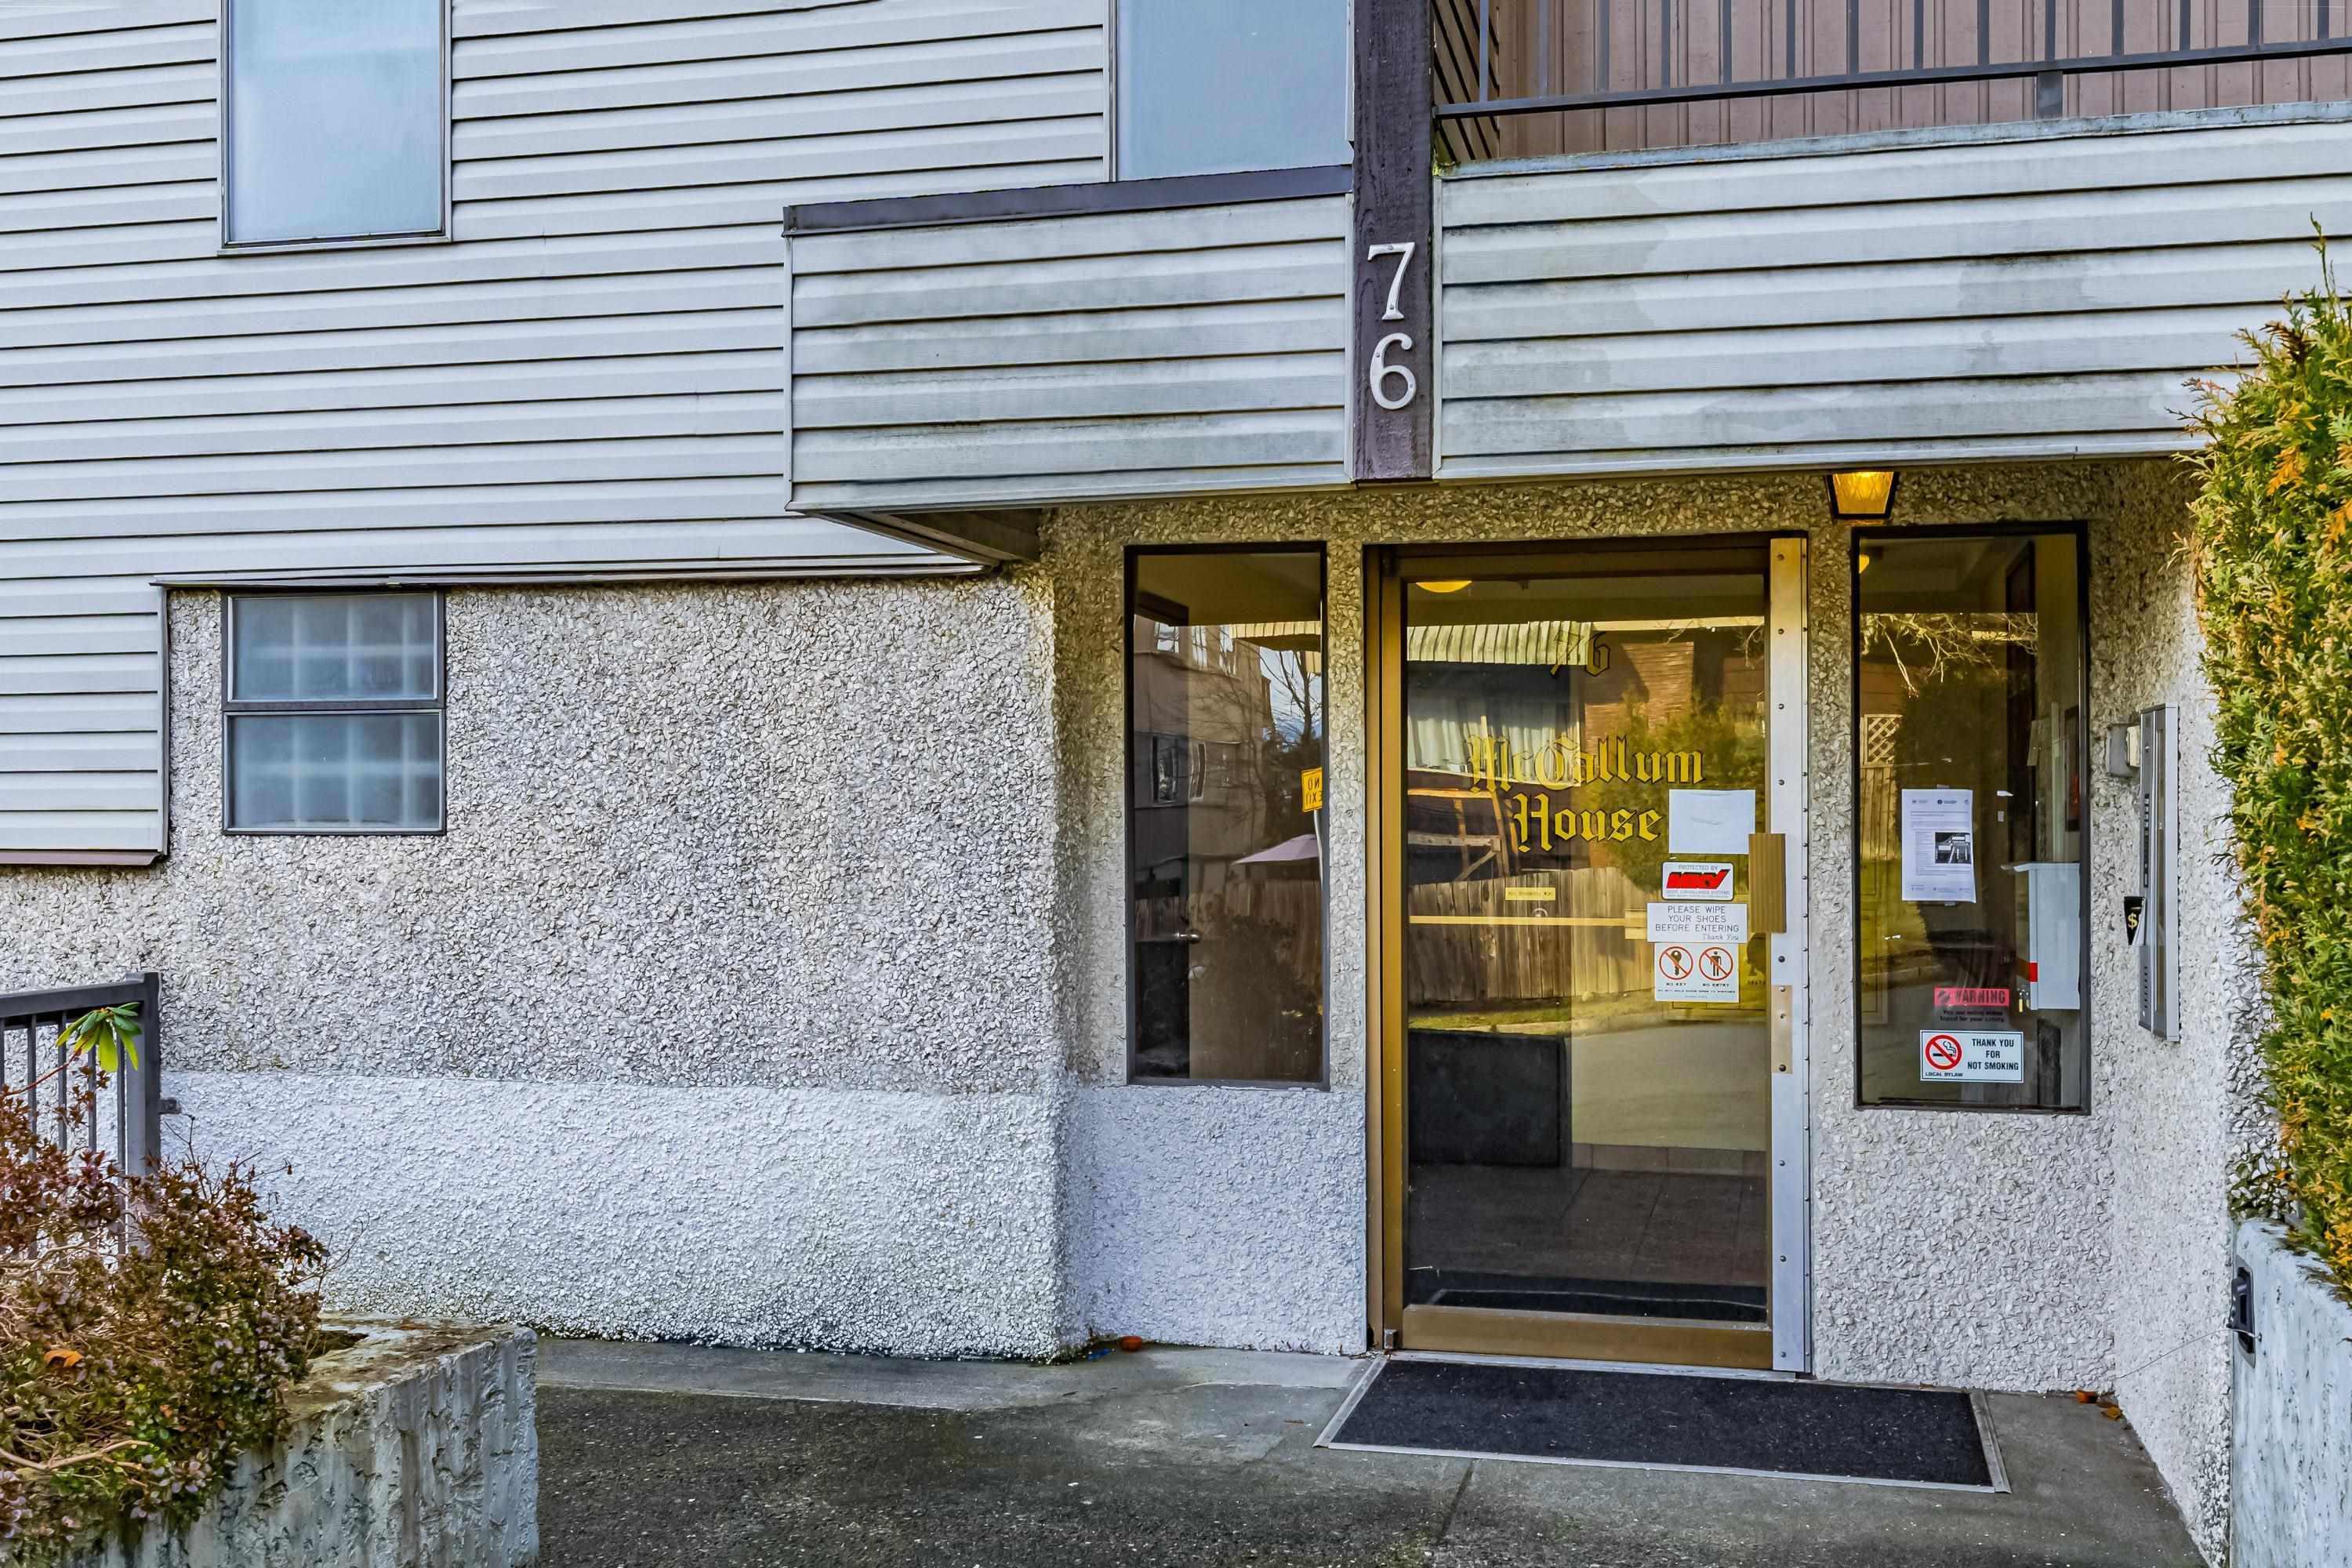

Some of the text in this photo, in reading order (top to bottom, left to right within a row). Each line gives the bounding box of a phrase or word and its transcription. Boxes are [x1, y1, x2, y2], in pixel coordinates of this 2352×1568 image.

[1367, 241, 1417, 410] 76
[1549, 629, 1612, 677] 76
[1512, 792, 1663, 853] House
[1705, 906, 1726, 914] WIPE
[1955, 989, 2005, 1004] WARNING
[1972, 1038, 2014, 1047] THANK YOU
[1985, 1050, 2001, 1058] FOR
[1967, 1062, 2019, 1071] NOT SMOKING
